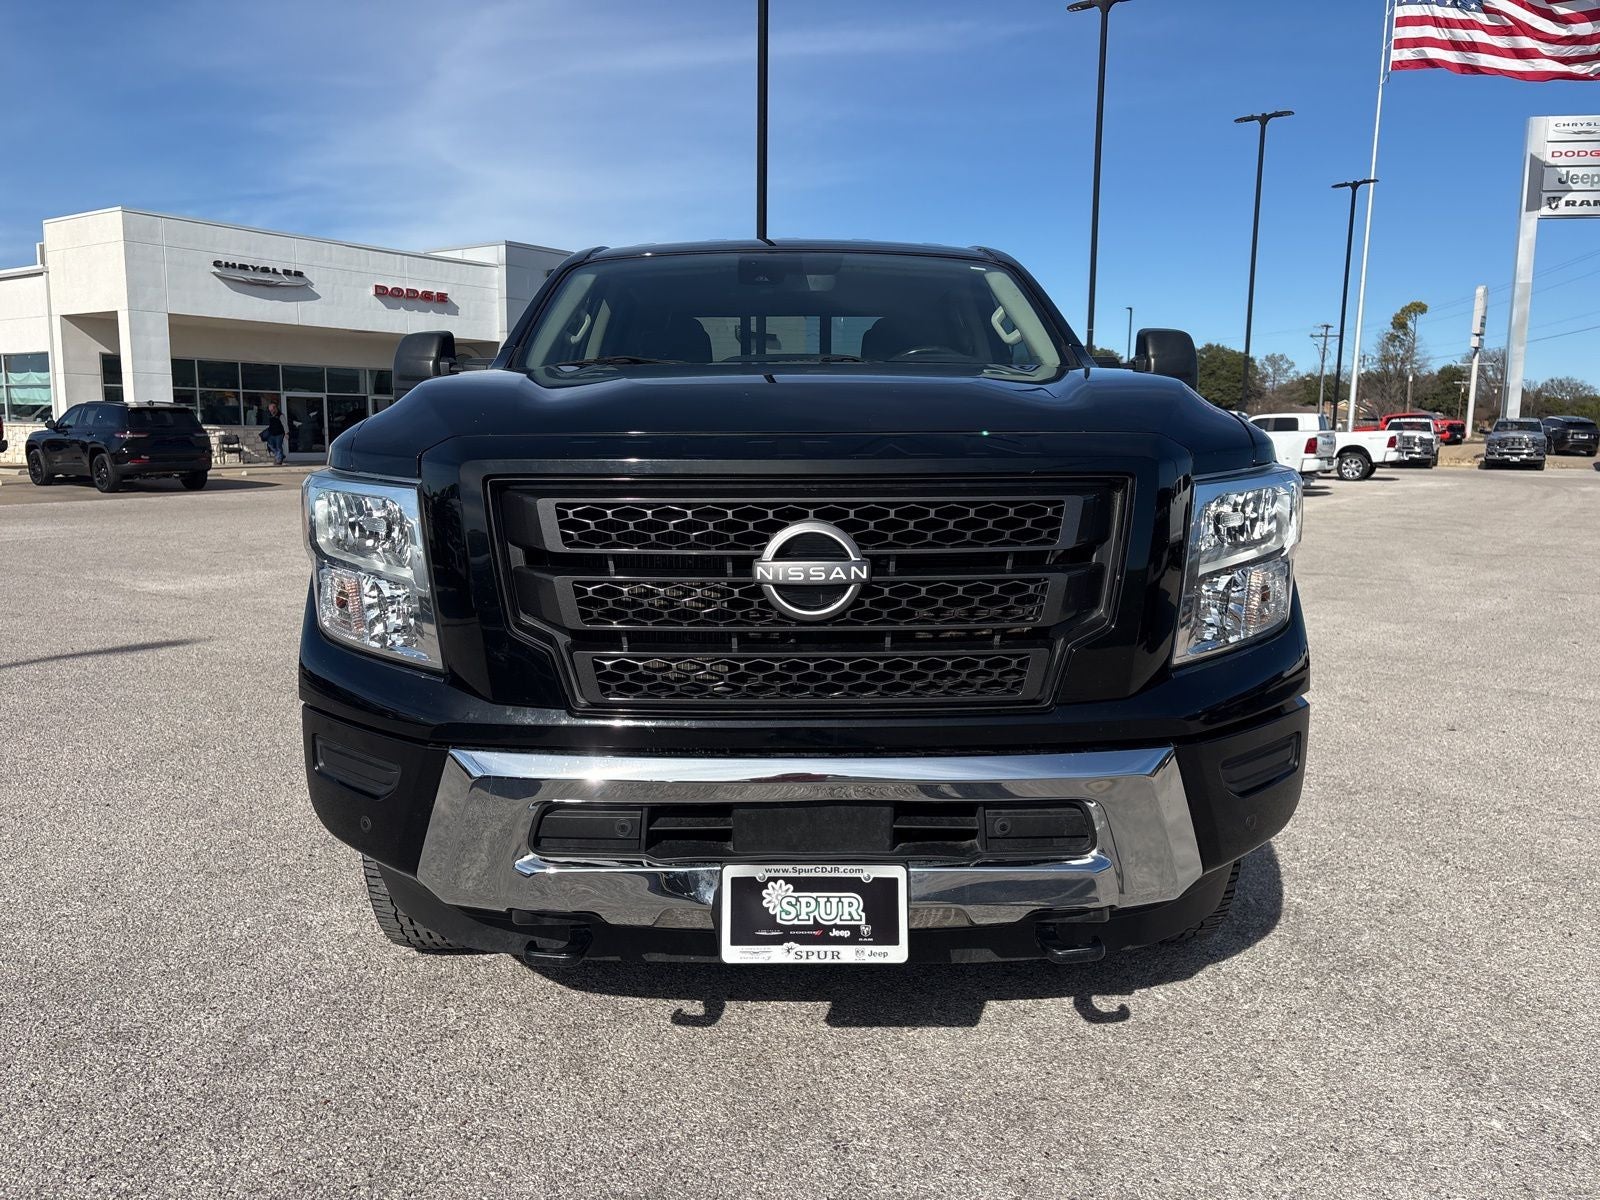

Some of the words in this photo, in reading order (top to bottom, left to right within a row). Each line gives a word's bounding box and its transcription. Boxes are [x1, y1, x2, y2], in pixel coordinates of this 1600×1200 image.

[1557, 170, 1600, 188] Jeep
[213, 260, 304, 277] CHRYSLER
[374, 284, 448, 303] DODGE
[756, 565, 868, 581] NISSAN
[765, 866, 864, 875] www.SpurCDJR.com
[779, 895, 863, 921] SPUR
[829, 928, 851, 937] Jeep
[794, 950, 841, 960] SPUR
[868, 950, 889, 958] Jeep
